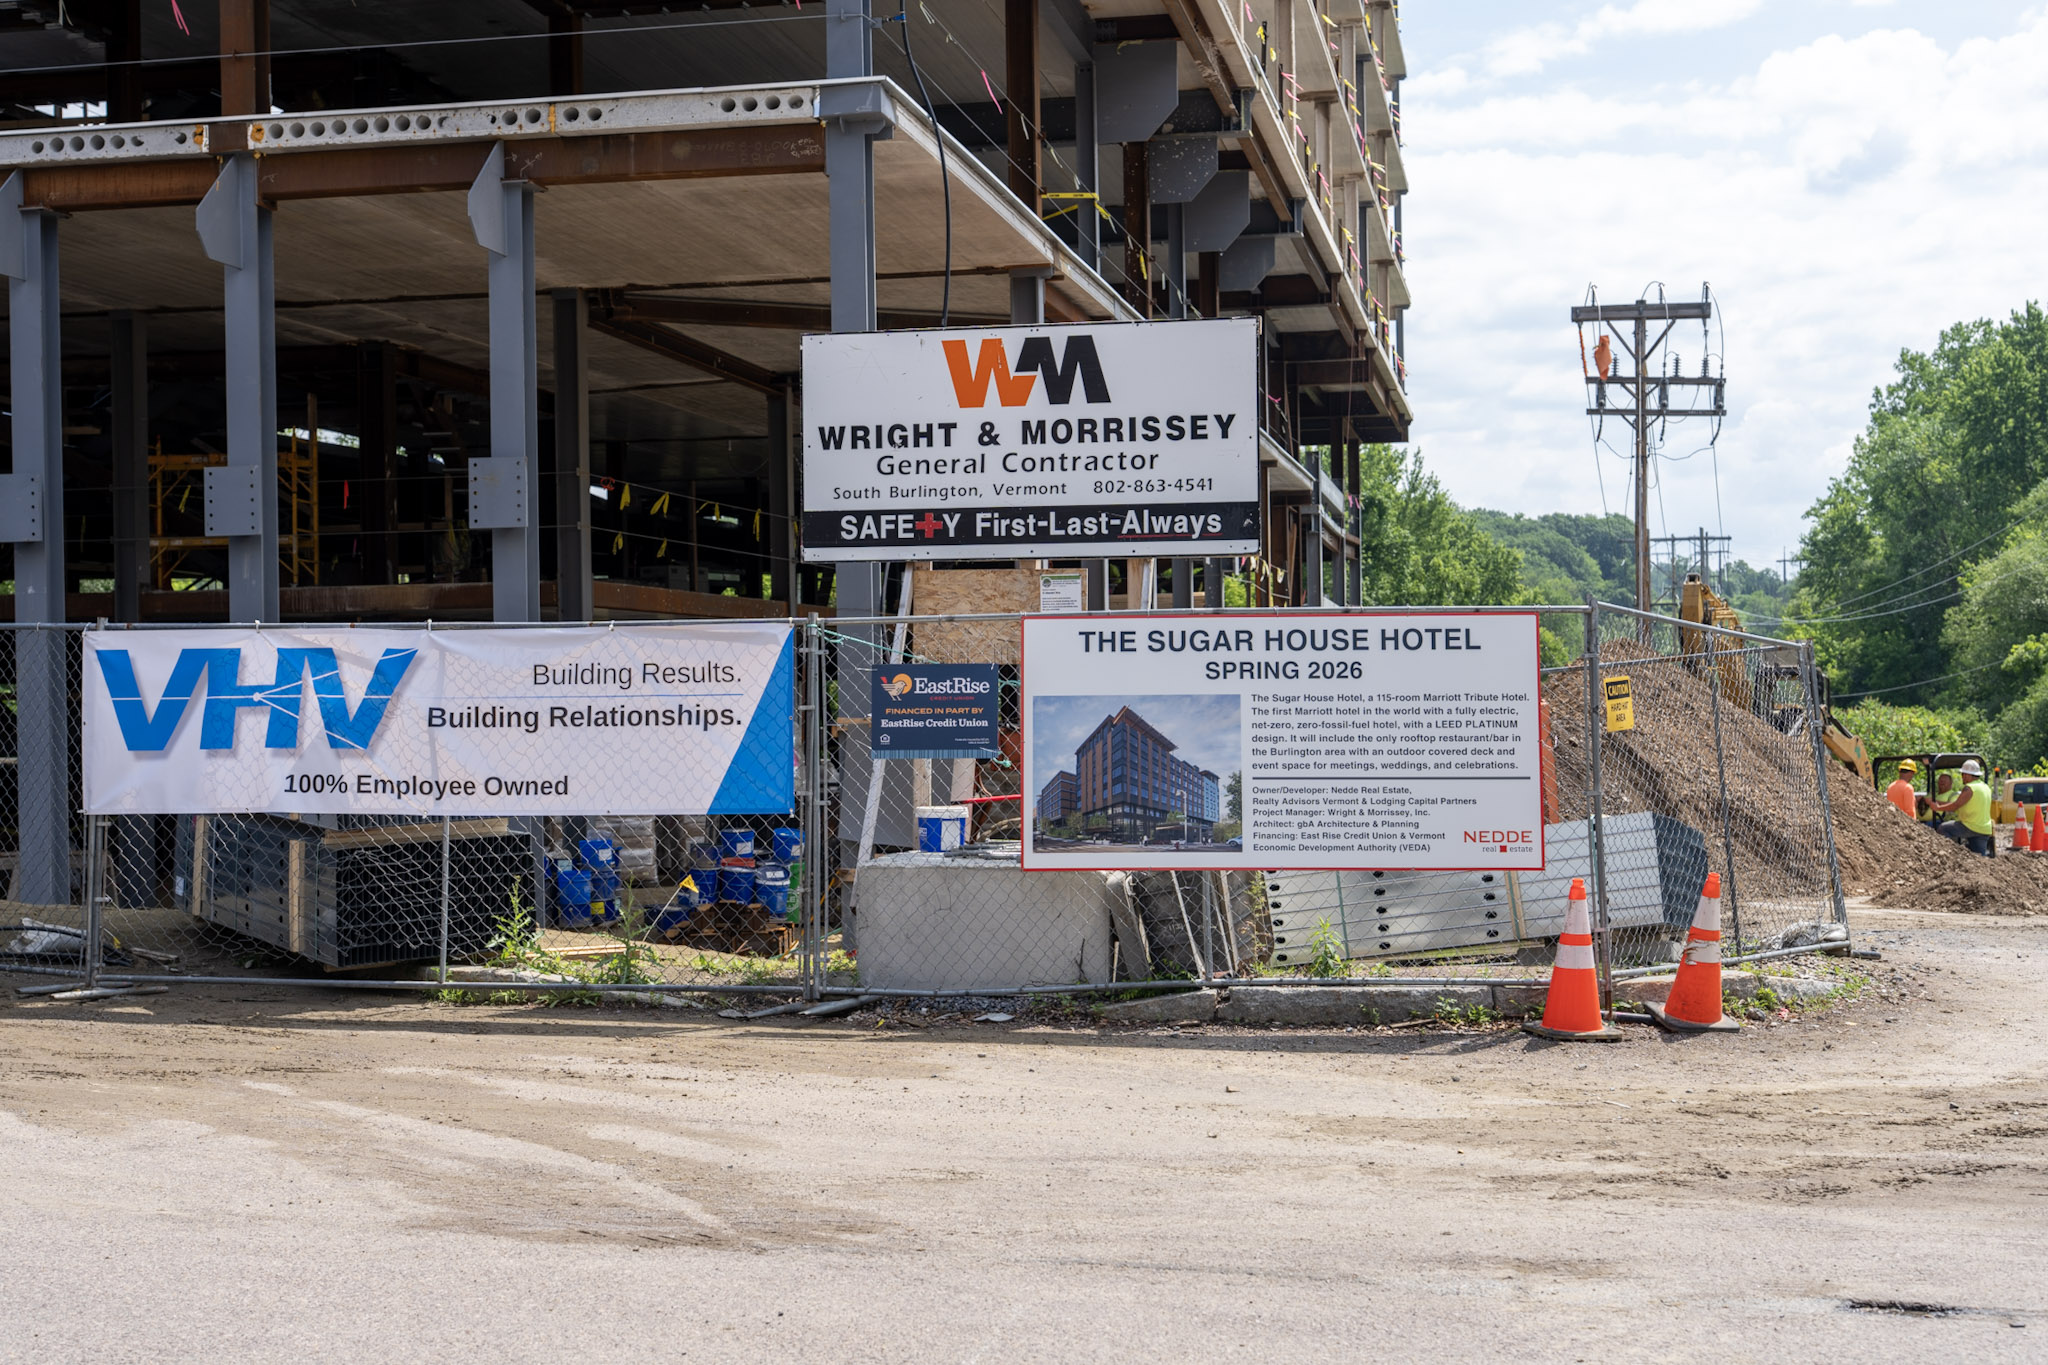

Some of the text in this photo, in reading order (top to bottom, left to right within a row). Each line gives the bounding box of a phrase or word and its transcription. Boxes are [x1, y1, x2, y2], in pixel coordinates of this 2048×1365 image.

[818, 414, 1235, 450] WRIGHT & MORRISSEY
[877, 452, 1158, 475] General Contractor
[834, 478, 1212, 501] South Burlington, Vermont 802-863-4541
[975, 508, 1222, 539] First-Last-Always
[1079, 628, 1481, 652] THE SUGAR HOUSE HOTEL
[1206, 661, 1362, 679] SPRING 2026
[532, 661, 742, 693] Building Results.
[914, 677, 990, 694] EastRise
[95, 647, 419, 753] VHV
[1251, 694, 1269, 702] The
[1272, 694, 1301, 704] Sugar
[1304, 694, 1334, 702] House
[1338, 694, 1365, 702] Hotel,
[1464, 693, 1498, 701] Tribute
[1502, 693, 1529, 701] Hotel.
[885, 707, 933, 715] FINANCED
[1252, 707, 1269, 715] The
[1295, 707, 1332, 715] Marriott
[1336, 707, 1359, 715] hotel
[1363, 707, 1372, 715] in
[1375, 707, 1390, 715] the
[1393, 707, 1420, 715] world
[1455, 707, 1476, 716] fully
[1480, 707, 1518, 715] electric,
[427, 703, 742, 734] Building Relationships.
[880, 718, 989, 728] EastRise Credit Union
[1373, 721, 1400, 729] hotel,
[1436, 720, 1462, 728] LEED
[1466, 720, 1517, 728] PLATINUM
[1252, 734, 1287, 744] design.
[1300, 734, 1316, 742] will
[1320, 734, 1354, 742] include
[1358, 734, 1373, 742] the
[1376, 734, 1397, 744] only
[1401, 734, 1436, 743] rooftop
[1439, 734, 1509, 742] restaurant/bar
[1252, 748, 1267, 756] the
[1271, 748, 1321, 757] Burlington
[1282, 763, 1310, 771] space
[1314, 761, 1327, 769] for
[1331, 761, 1377, 771] meetings,
[1381, 761, 1430, 771] weddings,
[1434, 761, 1451, 769] and
[1455, 761, 1518, 769] celebrations.
[283, 772, 569, 801] 100% Employee Owned
[1252, 787, 1328, 795] Owner/Developer:
[1253, 798, 1279, 806] Realty
[1371, 798, 1405, 806] Lodging
[1408, 798, 1437, 806] Capital
[1253, 809, 1283, 817] Project
[1286, 809, 1324, 817] Manager:
[1328, 809, 1356, 817] Wright
[1368, 809, 1412, 817] Morrissey,
[1297, 821, 1314, 829] gbA
[1382, 820, 1419, 829] Planning
[1253, 832, 1297, 841] Financing:
[1464, 830, 1533, 843] NEDDE
[1299, 844, 1354, 852] Development
[1357, 844, 1396, 853] Authority
[1399, 844, 1430, 852] (VEDA)
[1482, 845, 1533, 853] real estate
